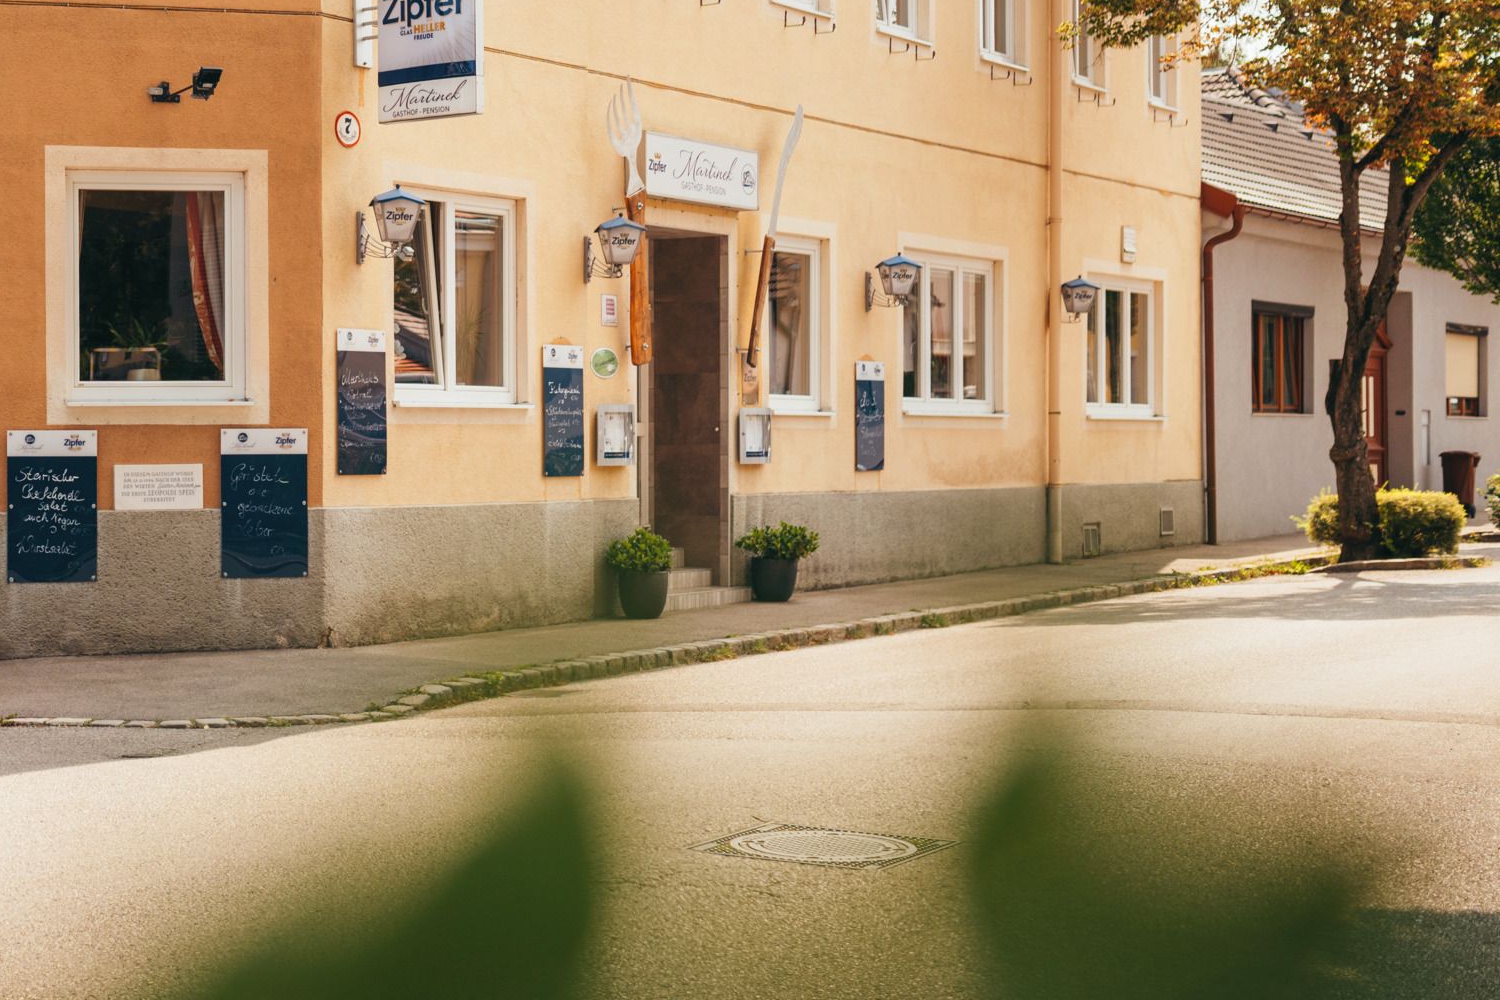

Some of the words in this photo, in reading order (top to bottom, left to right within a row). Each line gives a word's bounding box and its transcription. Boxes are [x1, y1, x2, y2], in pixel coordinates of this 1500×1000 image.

[413, 21, 446, 34] HELLER
[413, 33, 434, 41] FREUDE
[383, 79, 467, 113] Martinek
[392, 108, 419, 118] GASTHOF
[422, 105, 450, 115] PENSION
[648, 158, 667, 174] Zipfer
[672, 149, 738, 182] Martinek
[386, 210, 413, 221] Zipfer
[612, 236, 636, 246] Zipfer
[64, 438, 86, 449] Zipfer
[275, 437, 297, 447] Zipfer
